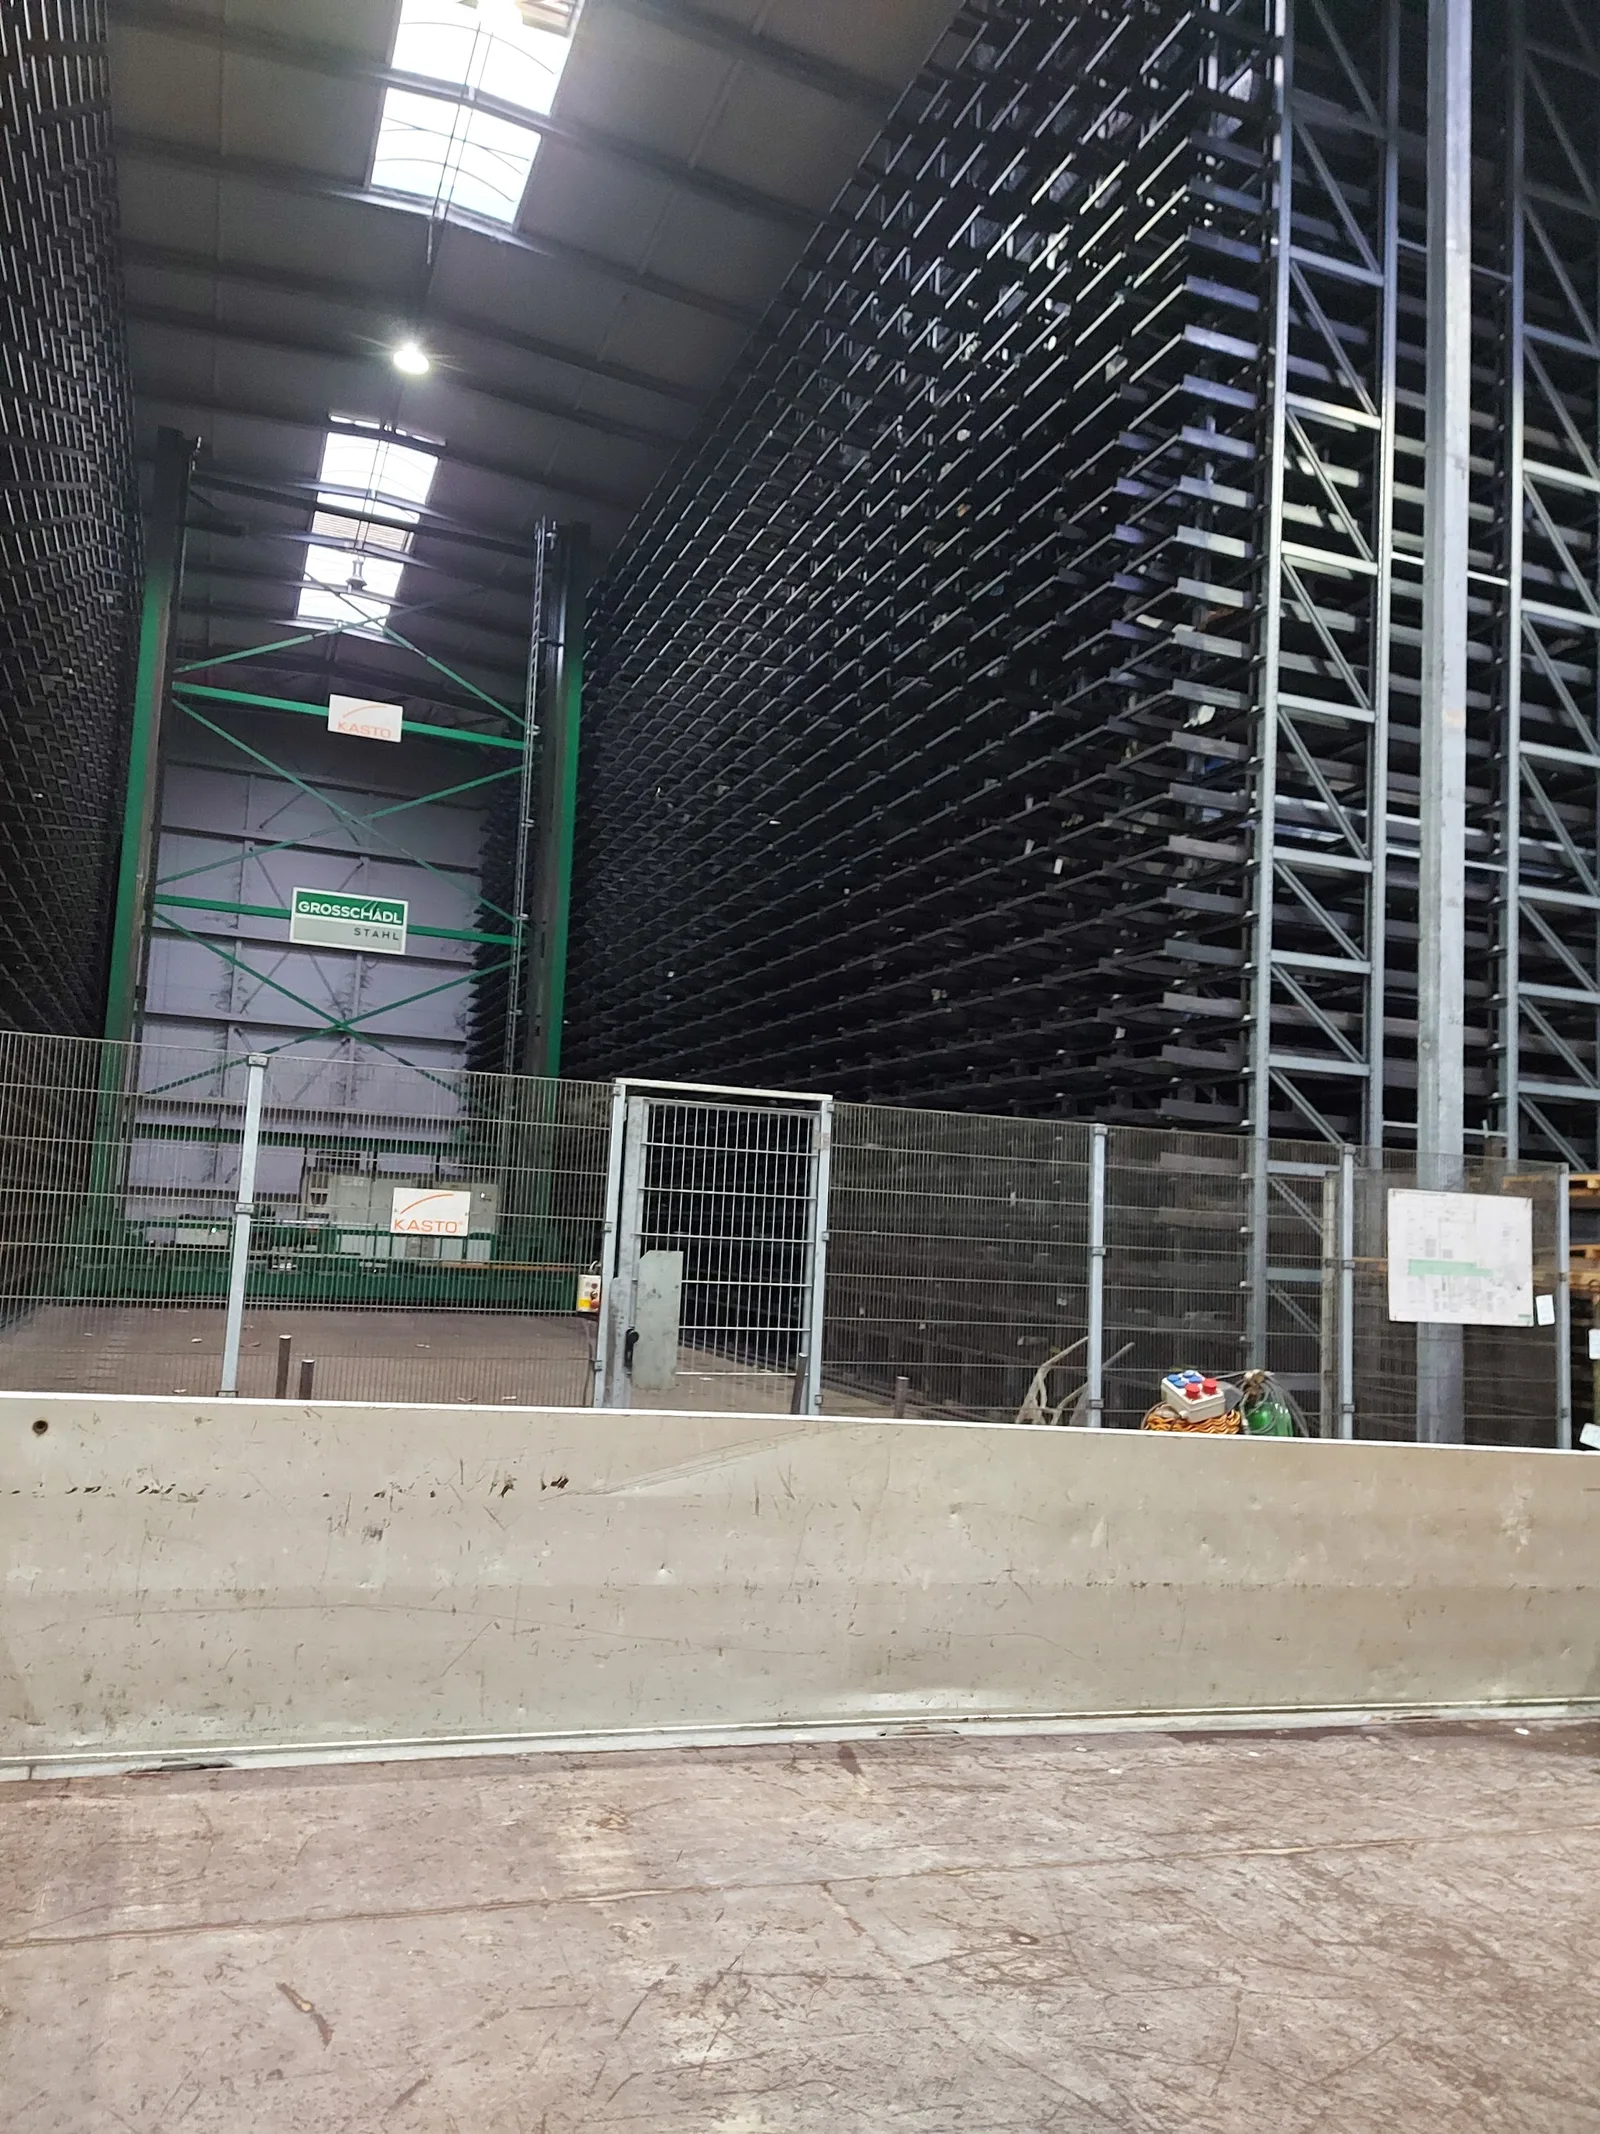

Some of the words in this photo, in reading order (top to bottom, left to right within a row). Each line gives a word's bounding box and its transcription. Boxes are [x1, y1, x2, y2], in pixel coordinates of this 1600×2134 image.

[337, 720, 391, 739] KASTO
[353, 927, 400, 941] STAHL
[394, 1218, 458, 1234] KASTO
